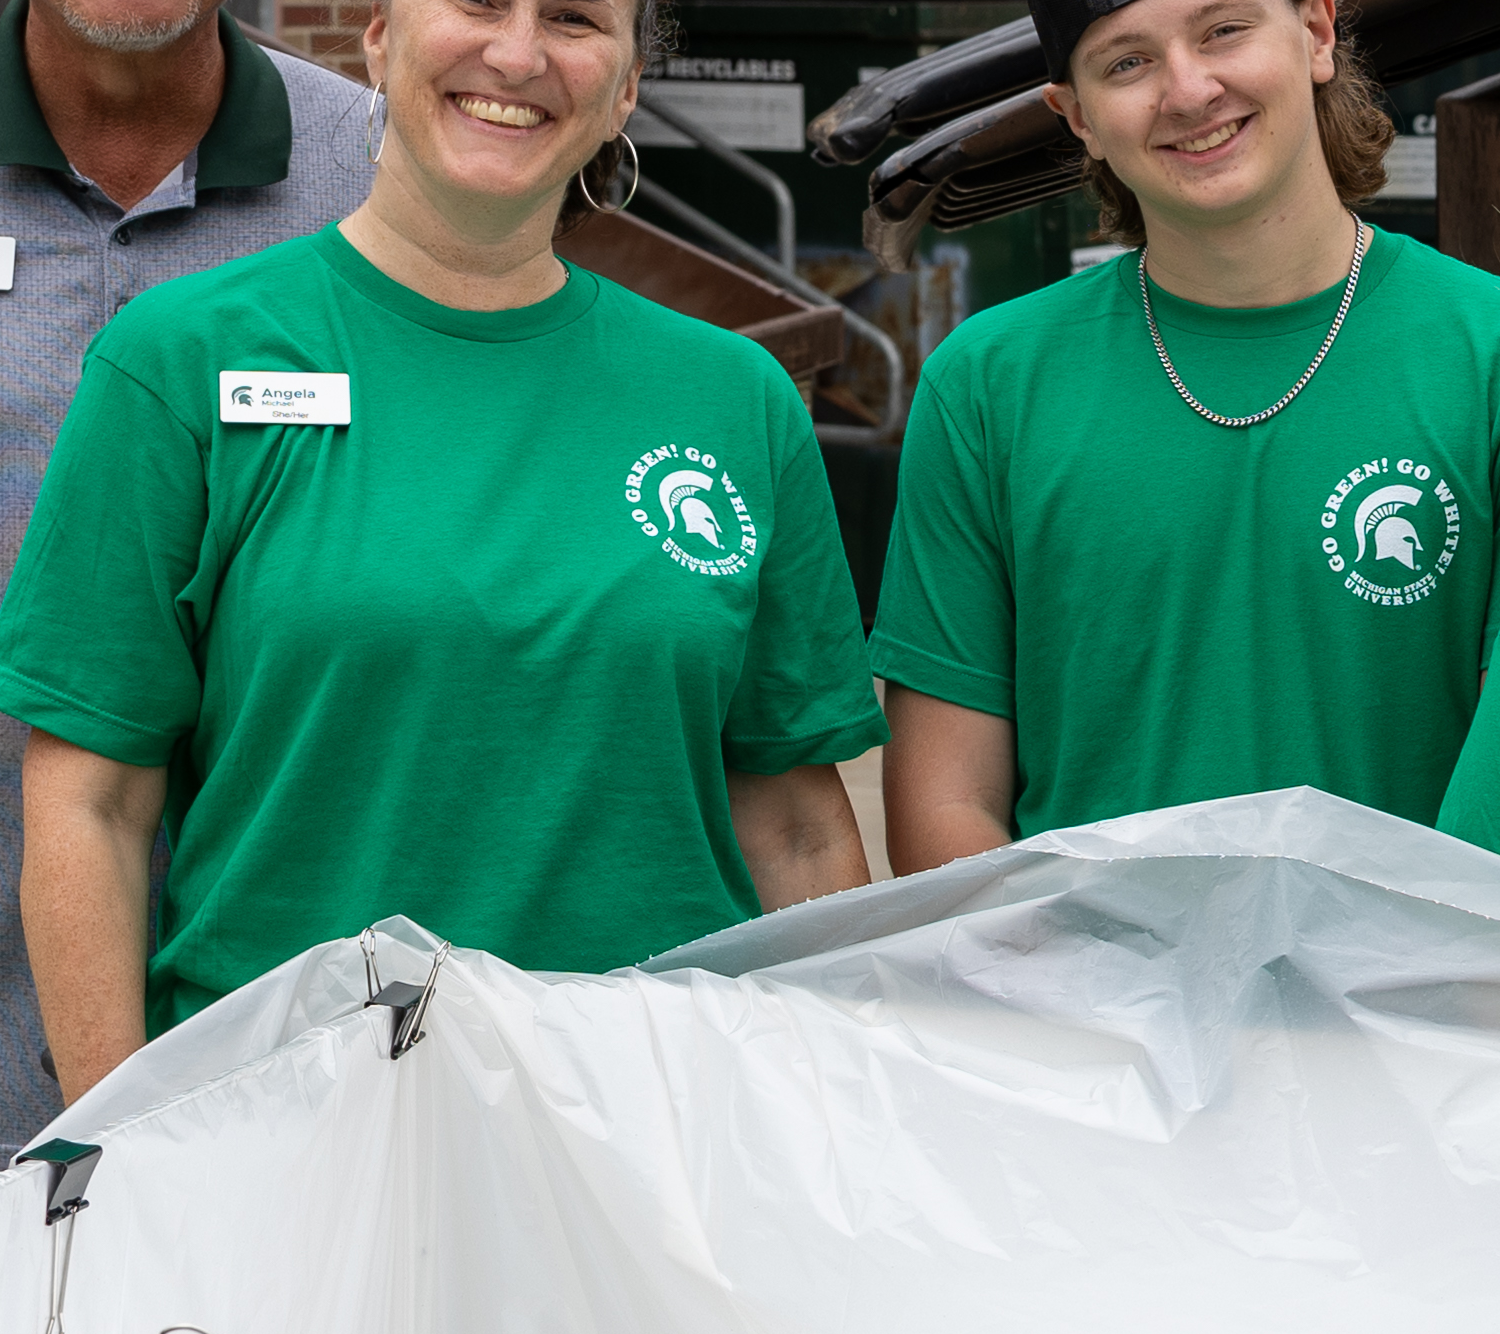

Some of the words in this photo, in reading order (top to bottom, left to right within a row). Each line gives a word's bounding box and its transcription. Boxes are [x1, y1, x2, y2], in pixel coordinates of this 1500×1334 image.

[667, 58, 797, 81] RECYCLABLES
[262, 388, 315, 400] Angela
[272, 410, 309, 419] She/Her
[625, 443, 679, 503] GREEN!
[684, 447, 717, 469] GO
[1396, 458, 1431, 481] GO
[1321, 457, 1388, 529] GREEN!
[631, 508, 659, 537] GO
[721, 470, 757, 556] WHITE!
[1434, 478, 1460, 575] WHITE!
[661, 540, 748, 576] UNIVERSITY
[666, 537, 715, 567] MICHIGAN
[715, 552, 739, 566] STATE
[1322, 537, 1345, 572] GO
[1344, 576, 1438, 606] UNIVERSITY
[1349, 570, 1401, 595] MICHIGAN
[1403, 572, 1434, 594] STATE
